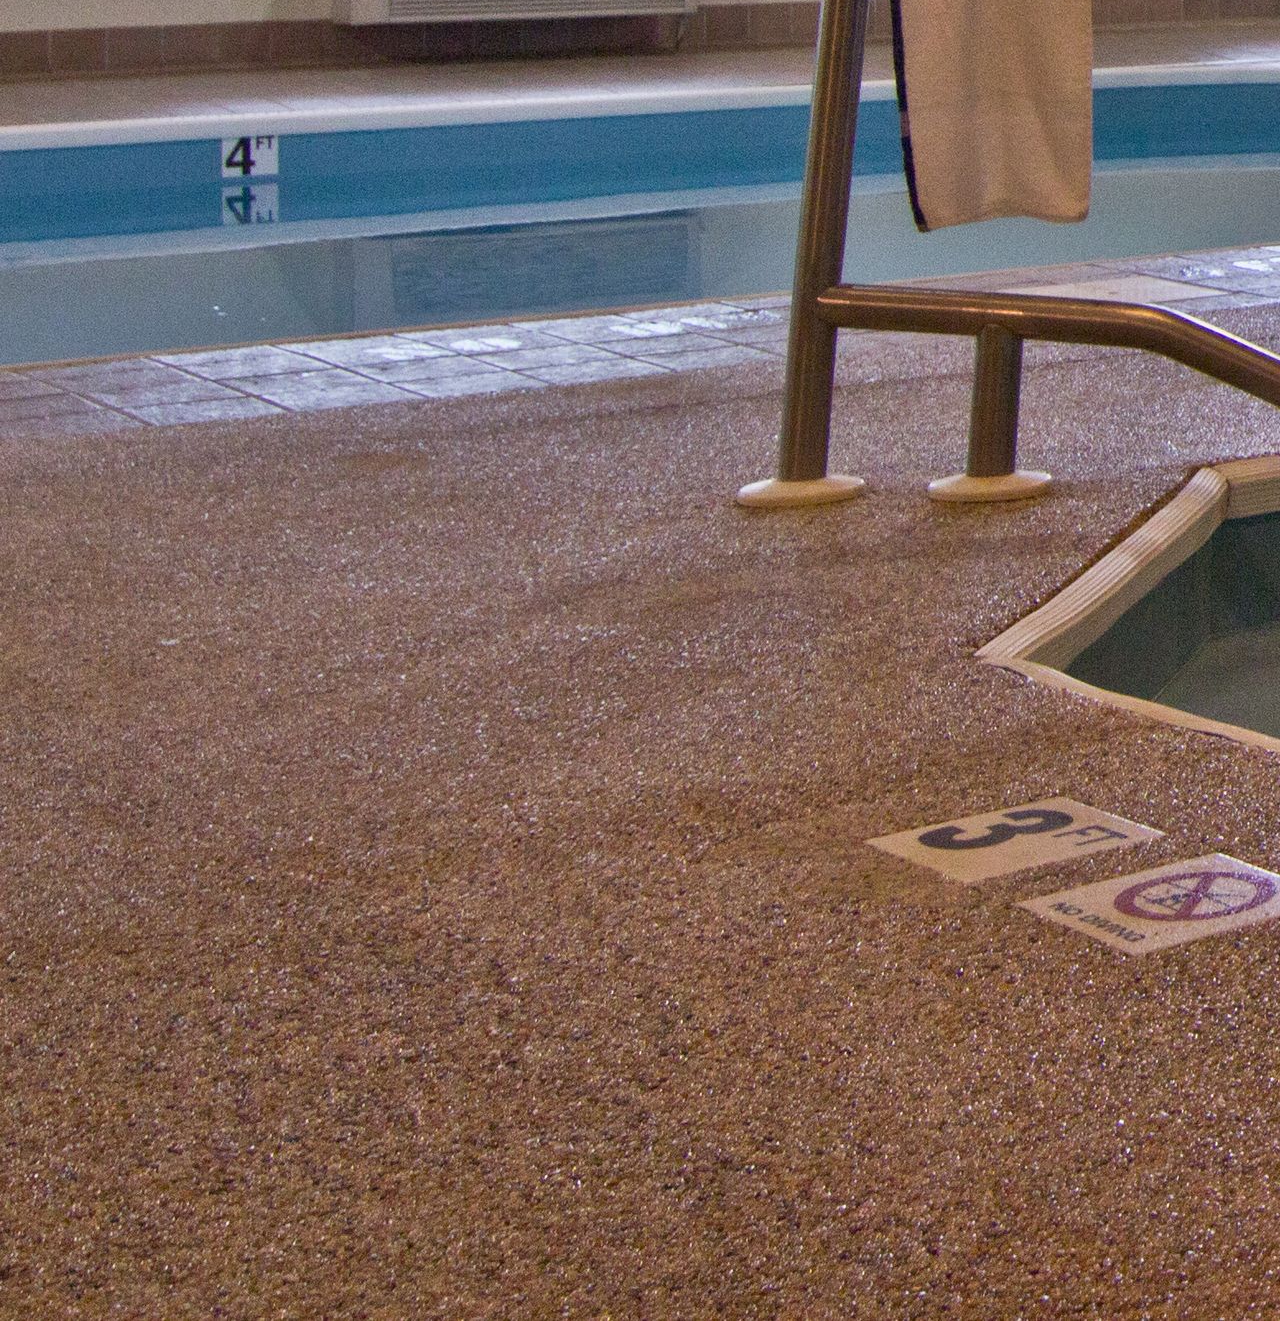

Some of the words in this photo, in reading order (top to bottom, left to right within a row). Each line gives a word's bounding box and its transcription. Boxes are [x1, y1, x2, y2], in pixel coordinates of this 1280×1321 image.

[225, 136, 256, 175] 4
[256, 135, 274, 150] FT
[917, 809, 1074, 850] 3
[1052, 825, 1128, 847] FT
[1048, 902, 1084, 916] NO
[1078, 914, 1146, 942] DIVING
